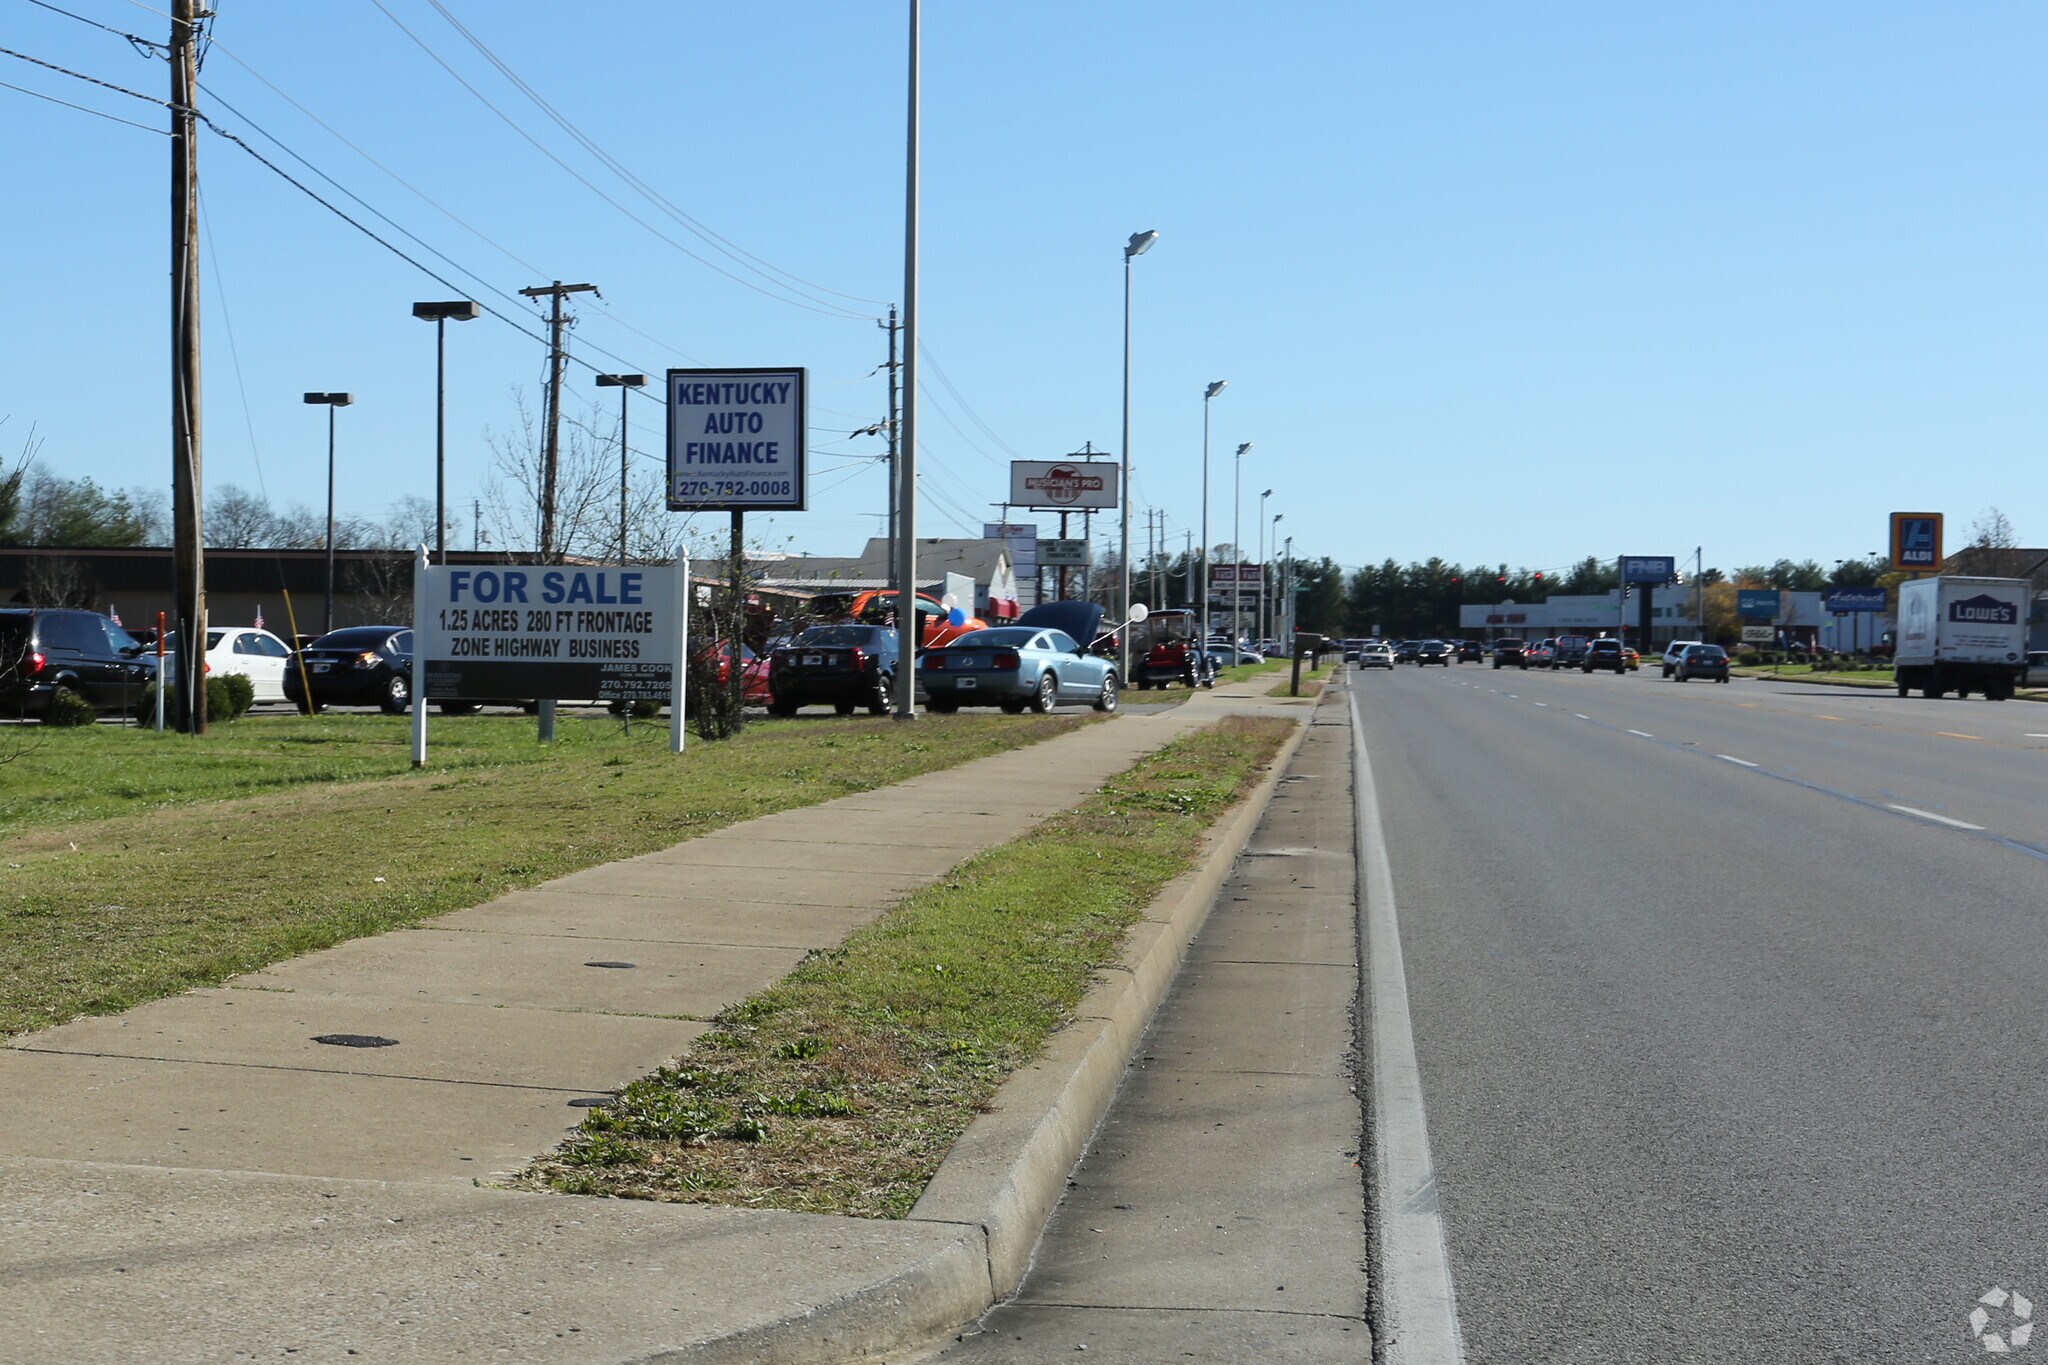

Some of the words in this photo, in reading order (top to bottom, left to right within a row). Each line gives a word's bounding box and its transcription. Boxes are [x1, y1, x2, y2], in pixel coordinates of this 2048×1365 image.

[678, 383, 791, 405] KENTUCKY
[704, 412, 763, 434] AUTO
[686, 442, 779, 464] FINANCE
[678, 481, 790, 496] 270-782-0008
[1081, 479, 1101, 488] PRO
[1902, 551, 1932, 561] ALDI
[1627, 561, 1667, 573] FNB
[450, 571, 529, 603] FOR
[542, 572, 643, 605] SALE
[1955, 605, 2011, 621] LOWE'S
[439, 609, 468, 631] 1.25
[471, 610, 518, 632] ACRES
[526, 610, 550, 632] 280
[556, 611, 574, 632] FT
[577, 611, 653, 633] FRONTAGE
[451, 637, 490, 657] ZONE
[494, 638, 561, 658] HIGHWAY
[569, 639, 640, 659] BUSINESS
[601, 664, 638, 672] JAMES
[641, 664, 672, 673] COOK
[601, 680, 672, 689] 270.792.7205
[598, 690, 621, 699] Office
